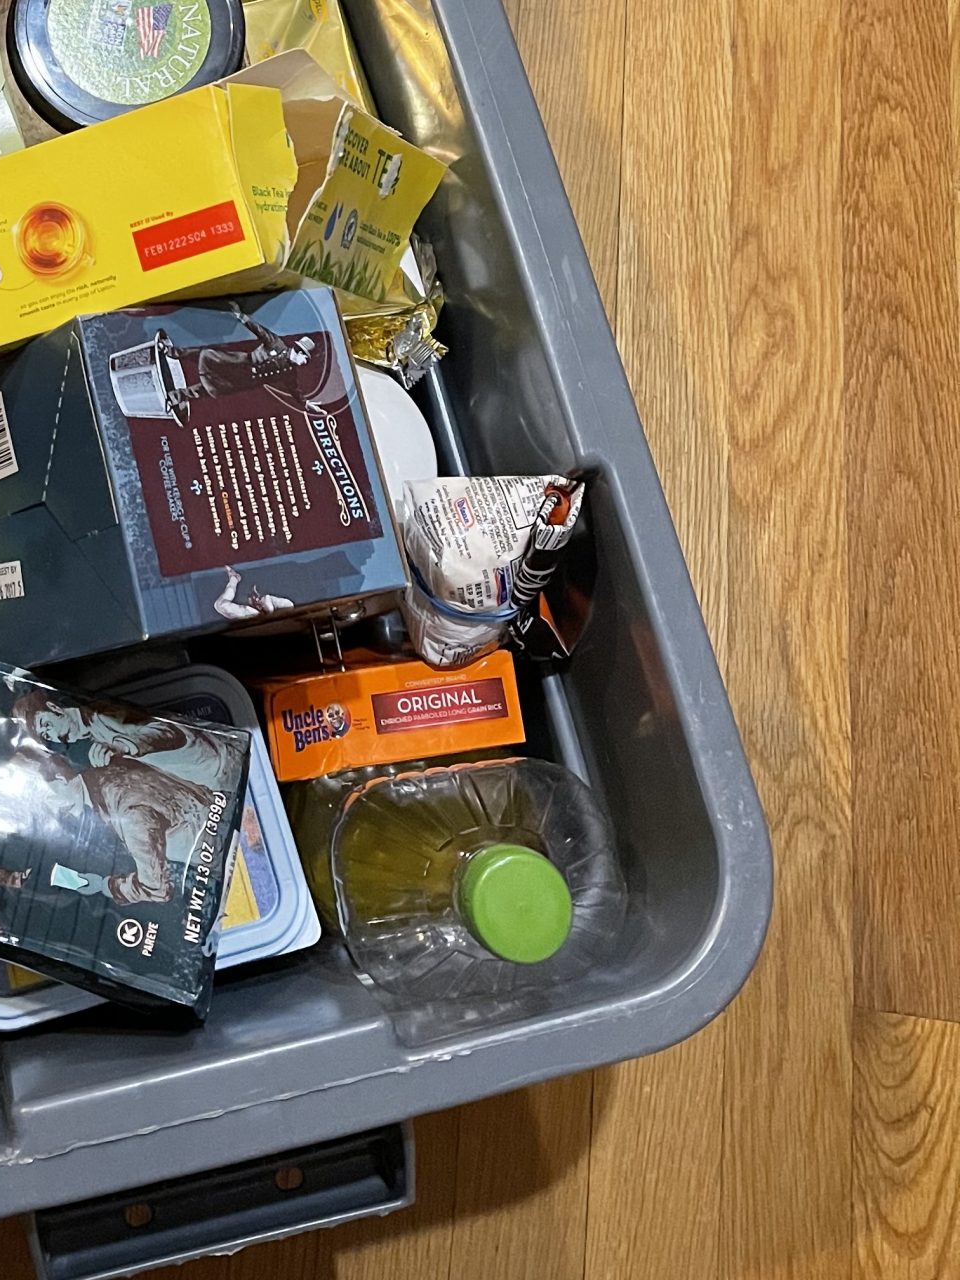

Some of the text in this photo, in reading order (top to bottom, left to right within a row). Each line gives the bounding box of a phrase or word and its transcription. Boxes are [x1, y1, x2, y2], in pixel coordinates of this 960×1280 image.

[118, 2, 202, 97] NATURAL
[250, 183, 284, 200] Black Tea
[210, 220, 235, 237] 1333
[159, 436, 170, 452] FOR
[192, 427, 202, 445] will
[234, 434, 243, 449] not
[199, 459, 208, 474] hot
[237, 449, 251, 483] remove
[270, 416, 288, 468] instructions
[285, 478, 297, 505] warm
[282, 414, 312, 510] Follow manufacturer's
[313, 419, 364, 520] DIRECTIONS
[158, 459, 179, 522] COFFEE MAKERS
[167, 467, 178, 487] WITH
[202, 474, 214, 496] after
[205, 425, 217, 454] button
[214, 465, 226, 490] brew.
[220, 491, 236, 530] Caution:
[228, 530, 240, 551] Cup
[218, 424, 252, 541] Place into brewer and push
[244, 420, 278, 538] Remove cup from package,
[257, 418, 294, 544] brewer. Select brew strength.
[171, 487, 185, 516] KEURIG
[245, 483, 259, 514] plastic
[207, 496, 224, 537] brewing.
[253, 515, 265, 543] cover.
[380, 703, 502, 726] ENRICHED PARBOILED LONG GRAIN RICE
[397, 689, 482, 714] ORIGINAL
[281, 706, 324, 732] Uncle
[293, 725, 332, 753] Ben's
[184, 792, 227, 943] NET WT. 13 OZ (369g)
[142, 922, 158, 956] PAREVE
